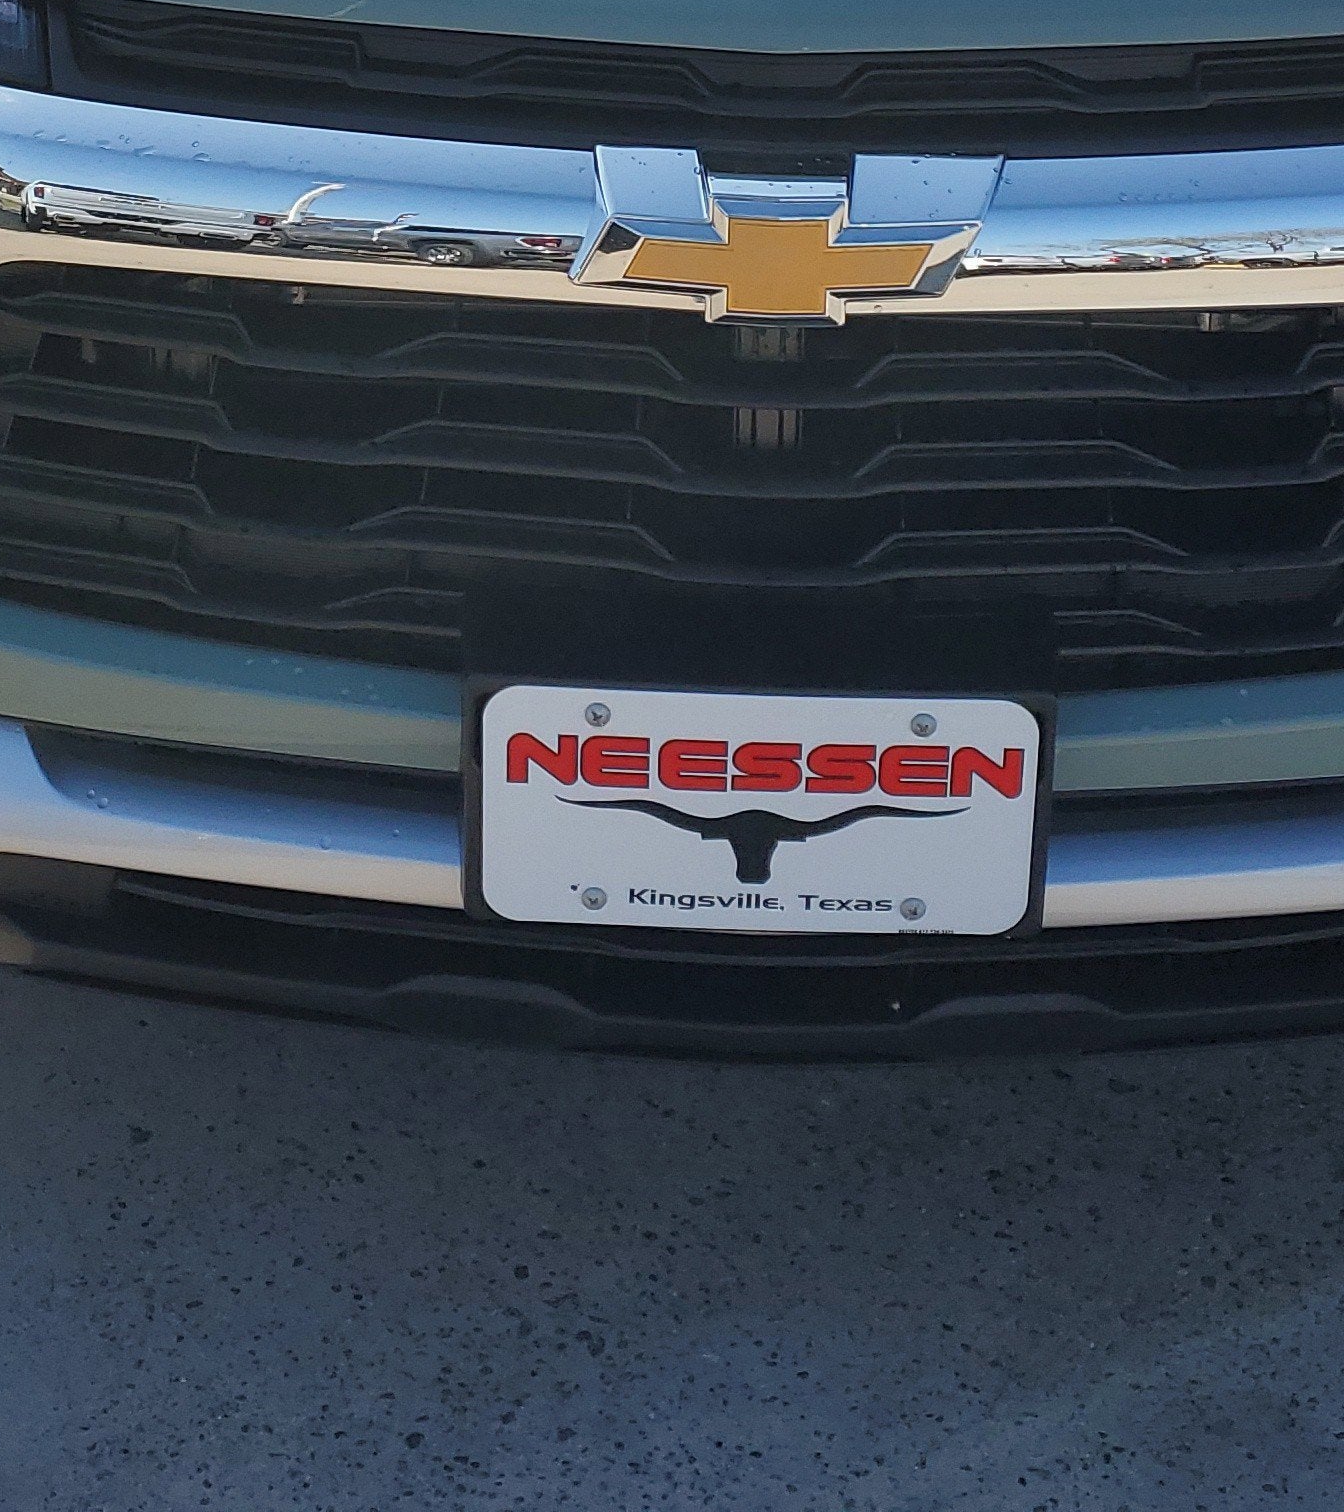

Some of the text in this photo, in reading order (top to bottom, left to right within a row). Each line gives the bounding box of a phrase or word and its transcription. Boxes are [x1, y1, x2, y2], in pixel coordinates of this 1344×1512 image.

[506, 732, 1025, 799] NEESSEN
[628, 888, 893, 912] Kingsville, Texas
